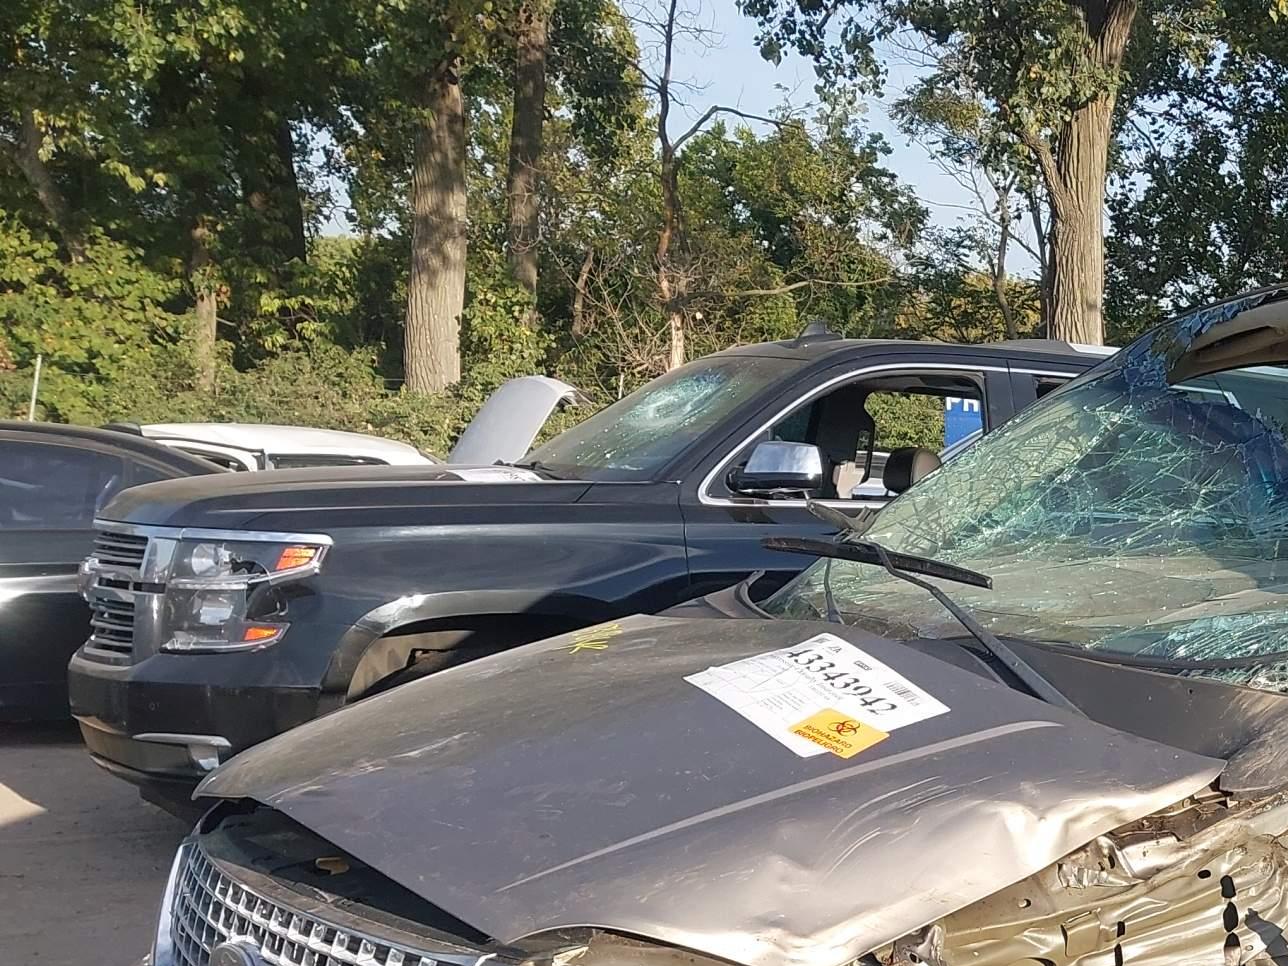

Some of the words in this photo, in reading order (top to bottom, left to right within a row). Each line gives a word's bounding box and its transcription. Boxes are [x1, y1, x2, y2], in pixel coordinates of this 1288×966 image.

[787, 649, 897, 715] 43343942
[794, 729, 844, 754] BIOPELIGRO
[803, 725, 853, 749] BIOHAZARD
